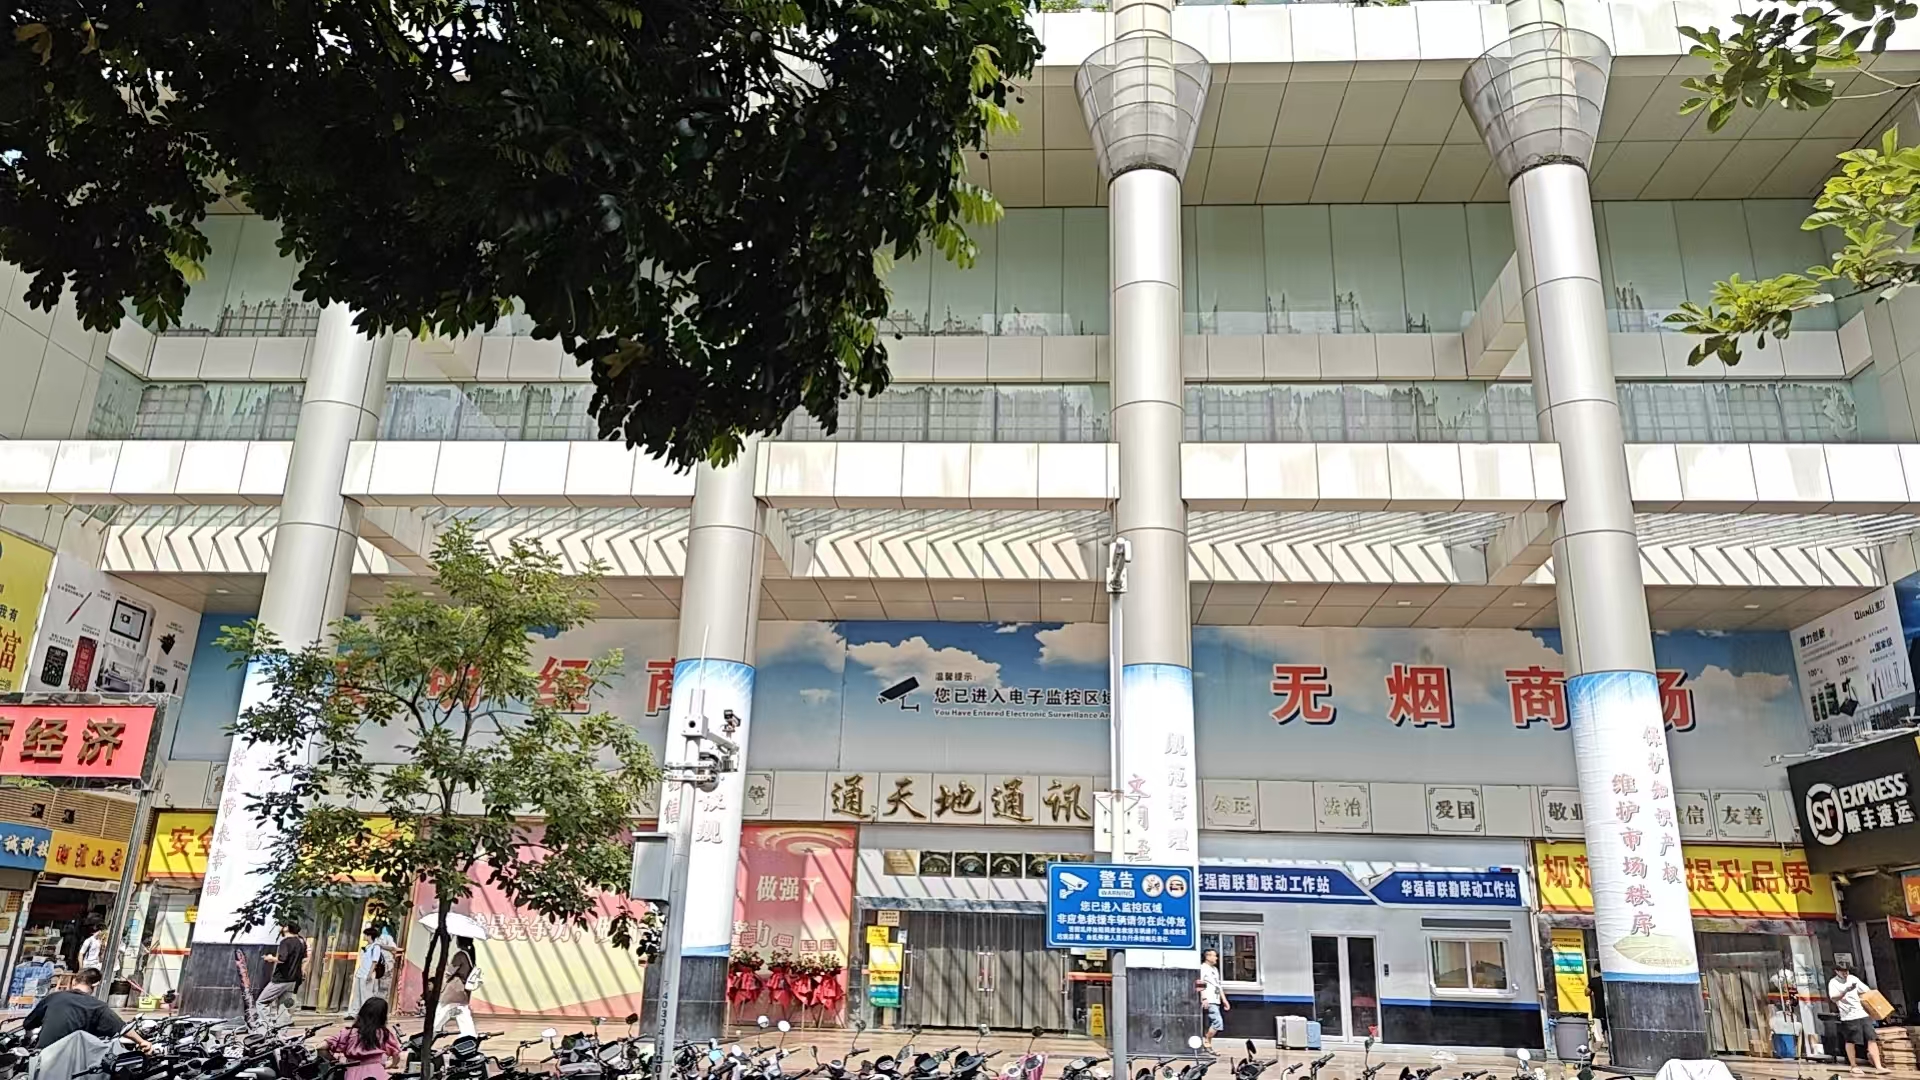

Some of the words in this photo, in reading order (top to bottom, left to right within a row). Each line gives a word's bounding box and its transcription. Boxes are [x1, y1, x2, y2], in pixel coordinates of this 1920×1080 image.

[1006, 710, 1046, 718] Electronic
[1048, 711, 1098, 719] Surveillance
[831, 774, 1092, 823] 通天地通讯
[1839, 773, 1907, 809] EXPRESS
[1323, 797, 1362, 817] 法治
[1435, 799, 1476, 820] 爱国
[1642, 726, 1682, 884] 保护知识产权
[1721, 805, 1764, 825] 友善
[1844, 800, 1914, 834] 顺丰速运
[1611, 773, 1656, 937] 维护市场秩序
[1099, 870, 1135, 889] 警告
[1686, 857, 1814, 897] 提升品质
[756, 875, 822, 903] 做强了
[1401, 880, 1517, 899] 华强南联勤联动工作站
[1080, 901, 1163, 914] 您已进入监控区域
[1056, 914, 1187, 928] 非应急救援车辆请勿在此停放
